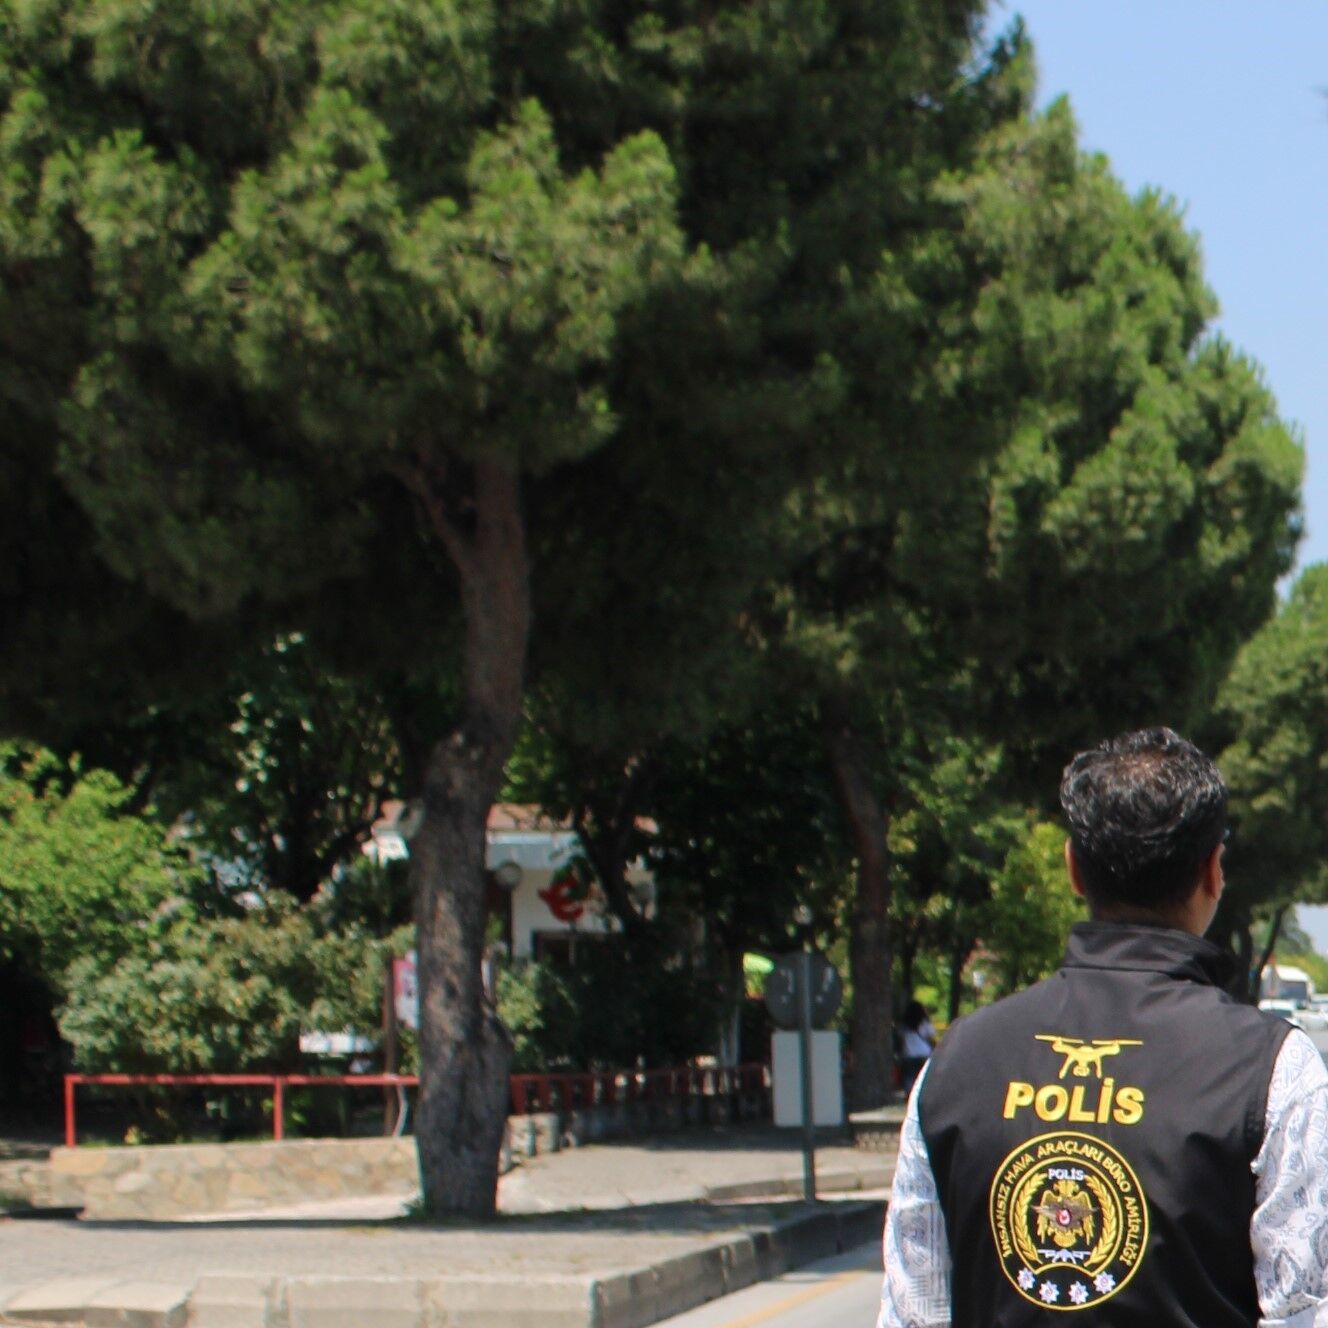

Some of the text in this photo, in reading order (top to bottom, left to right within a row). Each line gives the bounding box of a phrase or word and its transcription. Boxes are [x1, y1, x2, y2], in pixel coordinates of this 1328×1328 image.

[1003, 1077, 1145, 1125] POLİS
[1004, 1153, 1035, 1184] HAVA
[1037, 1140, 1104, 1163] ARAÇLARI
[1102, 1157, 1131, 1193] BÜRO
[1048, 1167, 1085, 1181] POLİS
